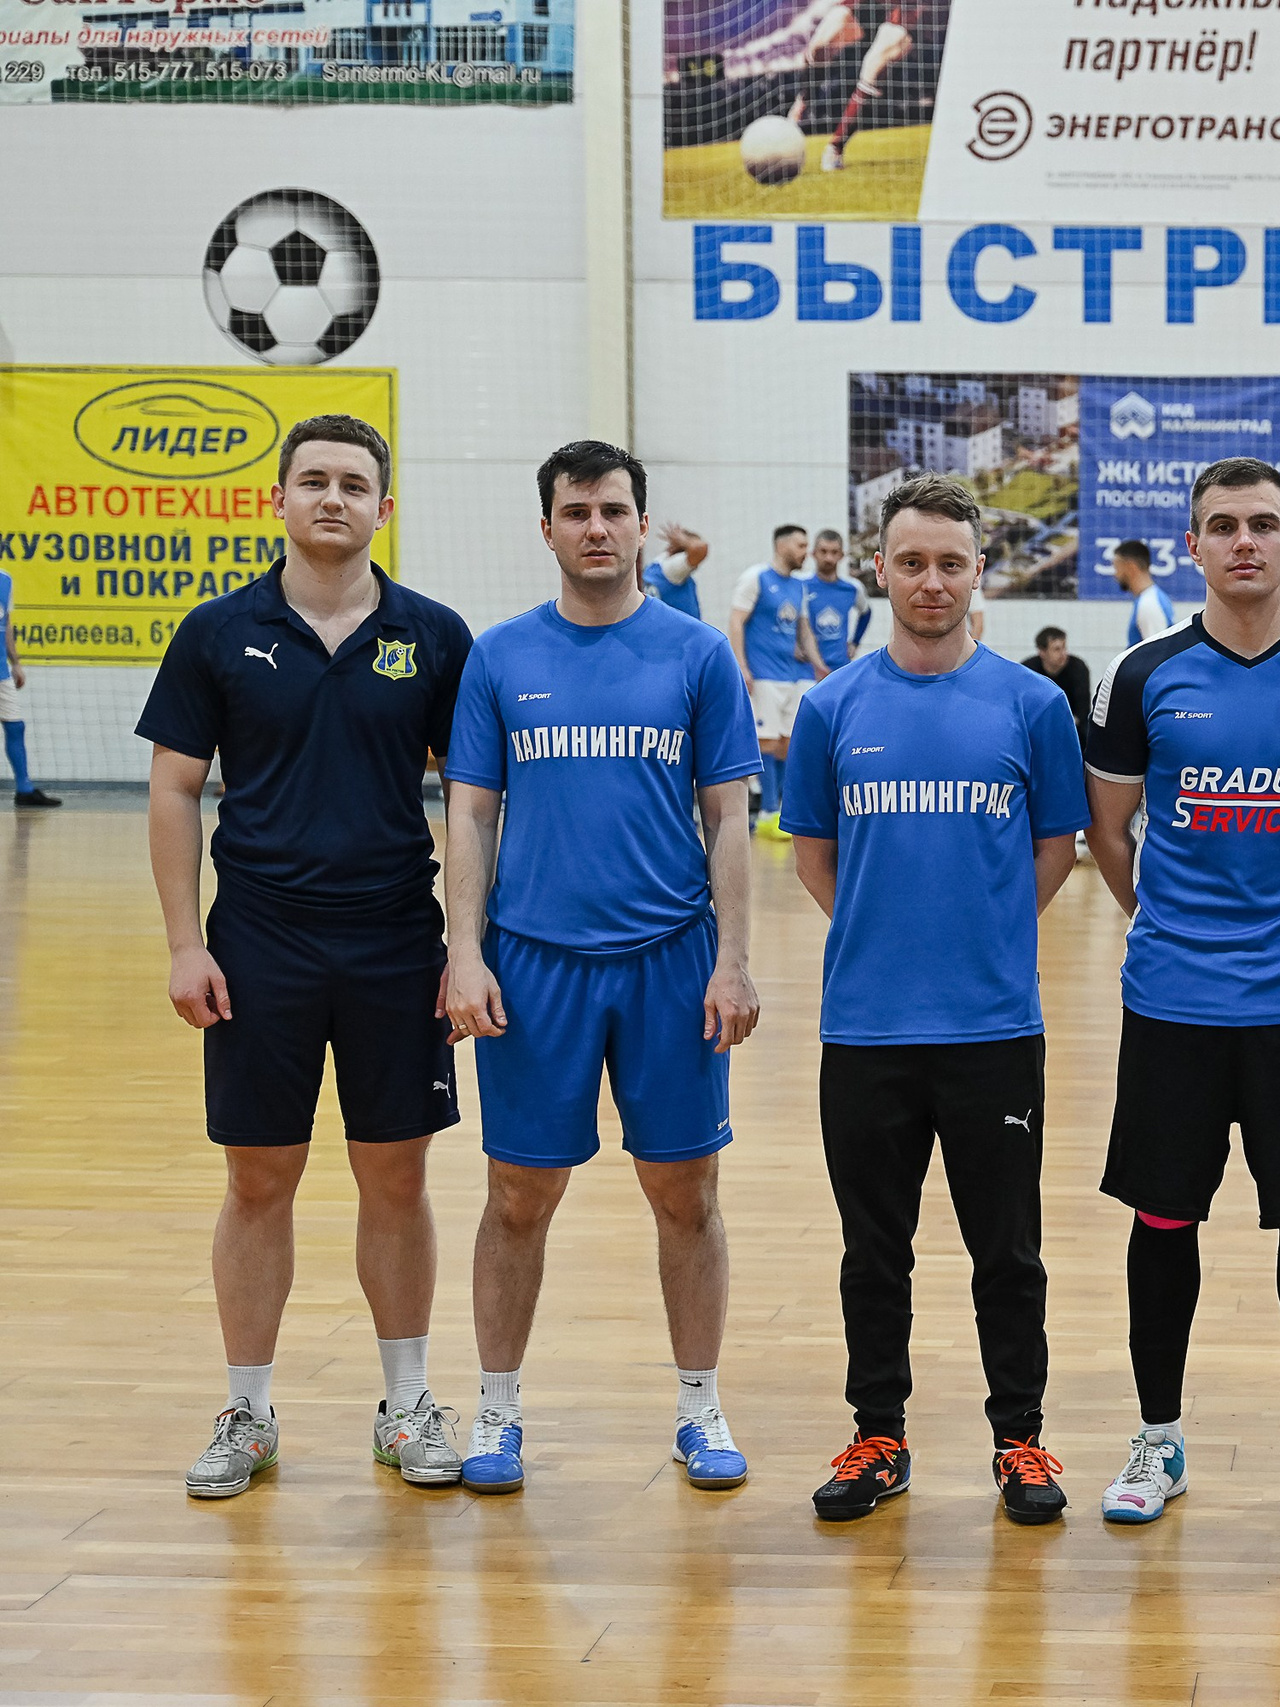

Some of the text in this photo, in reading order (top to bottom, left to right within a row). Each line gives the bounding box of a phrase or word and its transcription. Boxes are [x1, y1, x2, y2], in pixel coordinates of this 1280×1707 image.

[78, 24, 119, 45] для
[126, 29, 248, 49] наружных
[254, 27, 329, 45] сетей
[1063, 30, 1258, 82] партнёр!
[5, 60, 45, 83] 229
[205, 61, 288, 83] 515-073
[112, 426, 247, 457] ЛИДЕР
[1097, 460, 1141, 484] ЖК
[27, 485, 278, 523] АВТОТЕХЦЕН
[0, 528, 286, 563] КУЗОВНОЙ РЕМ
[61, 569, 268, 598] и ПОКРАС
[13, 624, 141, 647] нделеева,
[529, 692, 552, 700] SPORT
[511, 726, 685, 765] КАЛИНИНГРАД
[862, 746, 885, 754] SPORT
[843, 780, 1015, 819] КАЛИНИНГРАД
